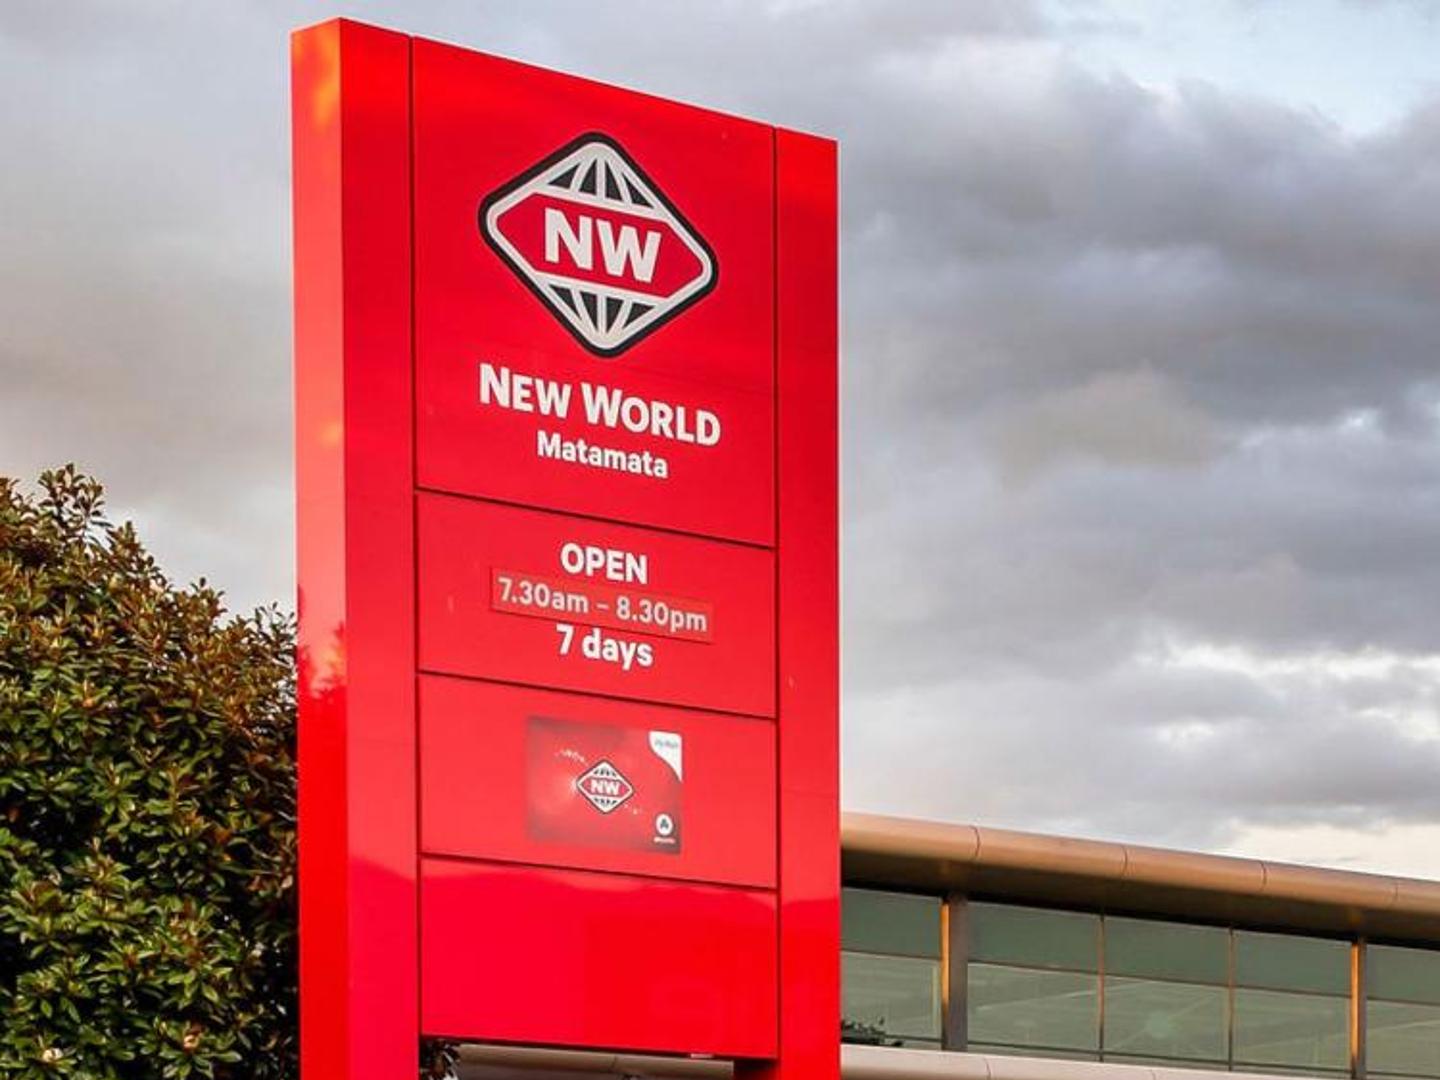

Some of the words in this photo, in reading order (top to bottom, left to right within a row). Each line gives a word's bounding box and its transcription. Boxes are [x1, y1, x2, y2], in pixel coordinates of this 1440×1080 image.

[544, 208, 662, 284] NW
[479, 363, 571, 420] NEW
[581, 382, 722, 447] WORLD
[537, 430, 669, 479] Matamata
[560, 543, 648, 584] OPEN
[497, 577, 589, 614] 7.30am
[616, 596, 708, 633] 8.30pm
[556, 624, 574, 655] 7
[582, 628, 654, 671] days
[590, 779, 620, 796] NW
